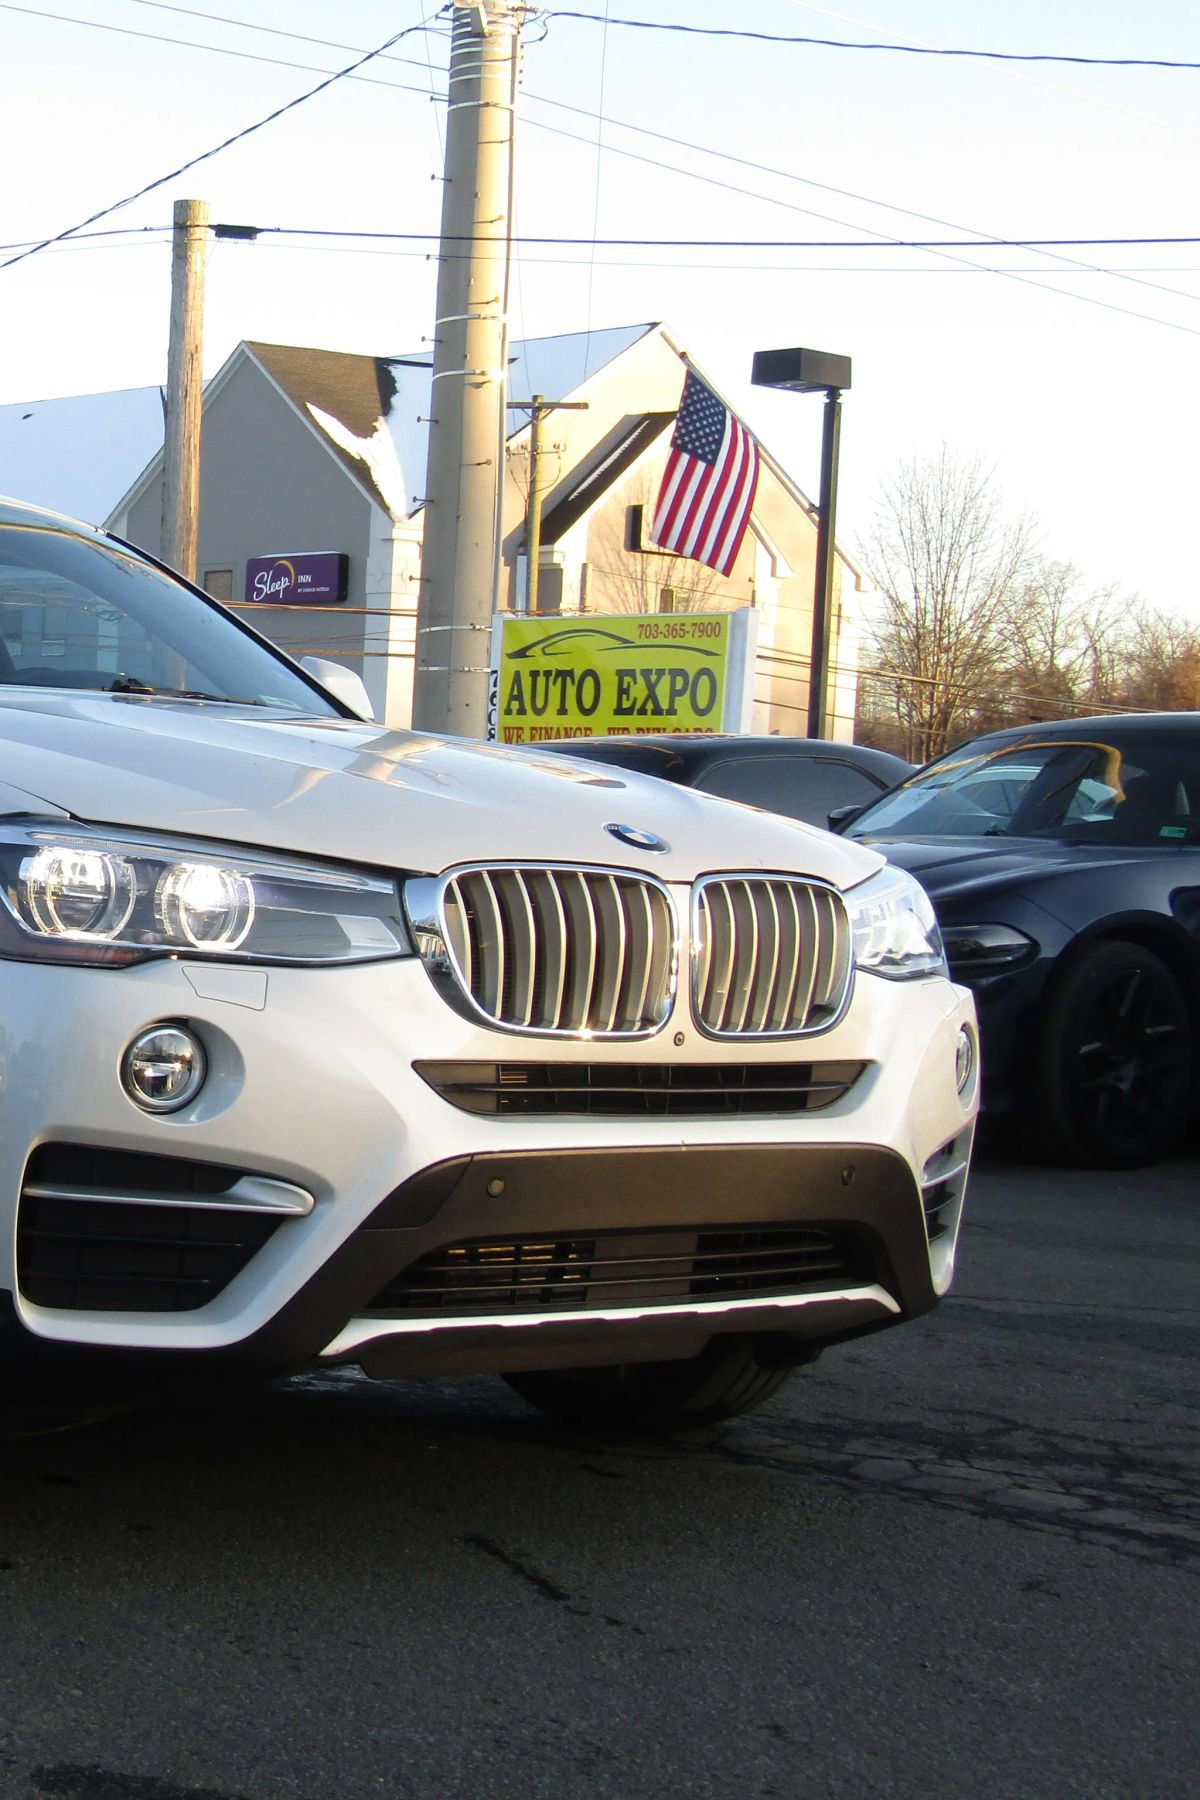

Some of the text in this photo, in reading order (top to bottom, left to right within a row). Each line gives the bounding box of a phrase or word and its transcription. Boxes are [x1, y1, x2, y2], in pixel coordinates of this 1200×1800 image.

[253, 569, 291, 601] Sleep
[297, 574, 312, 584] INN
[637, 621, 722, 640] 703-365-7900
[503, 667, 718, 717] AUTO EXPO
[503, 726, 526, 745] WE
